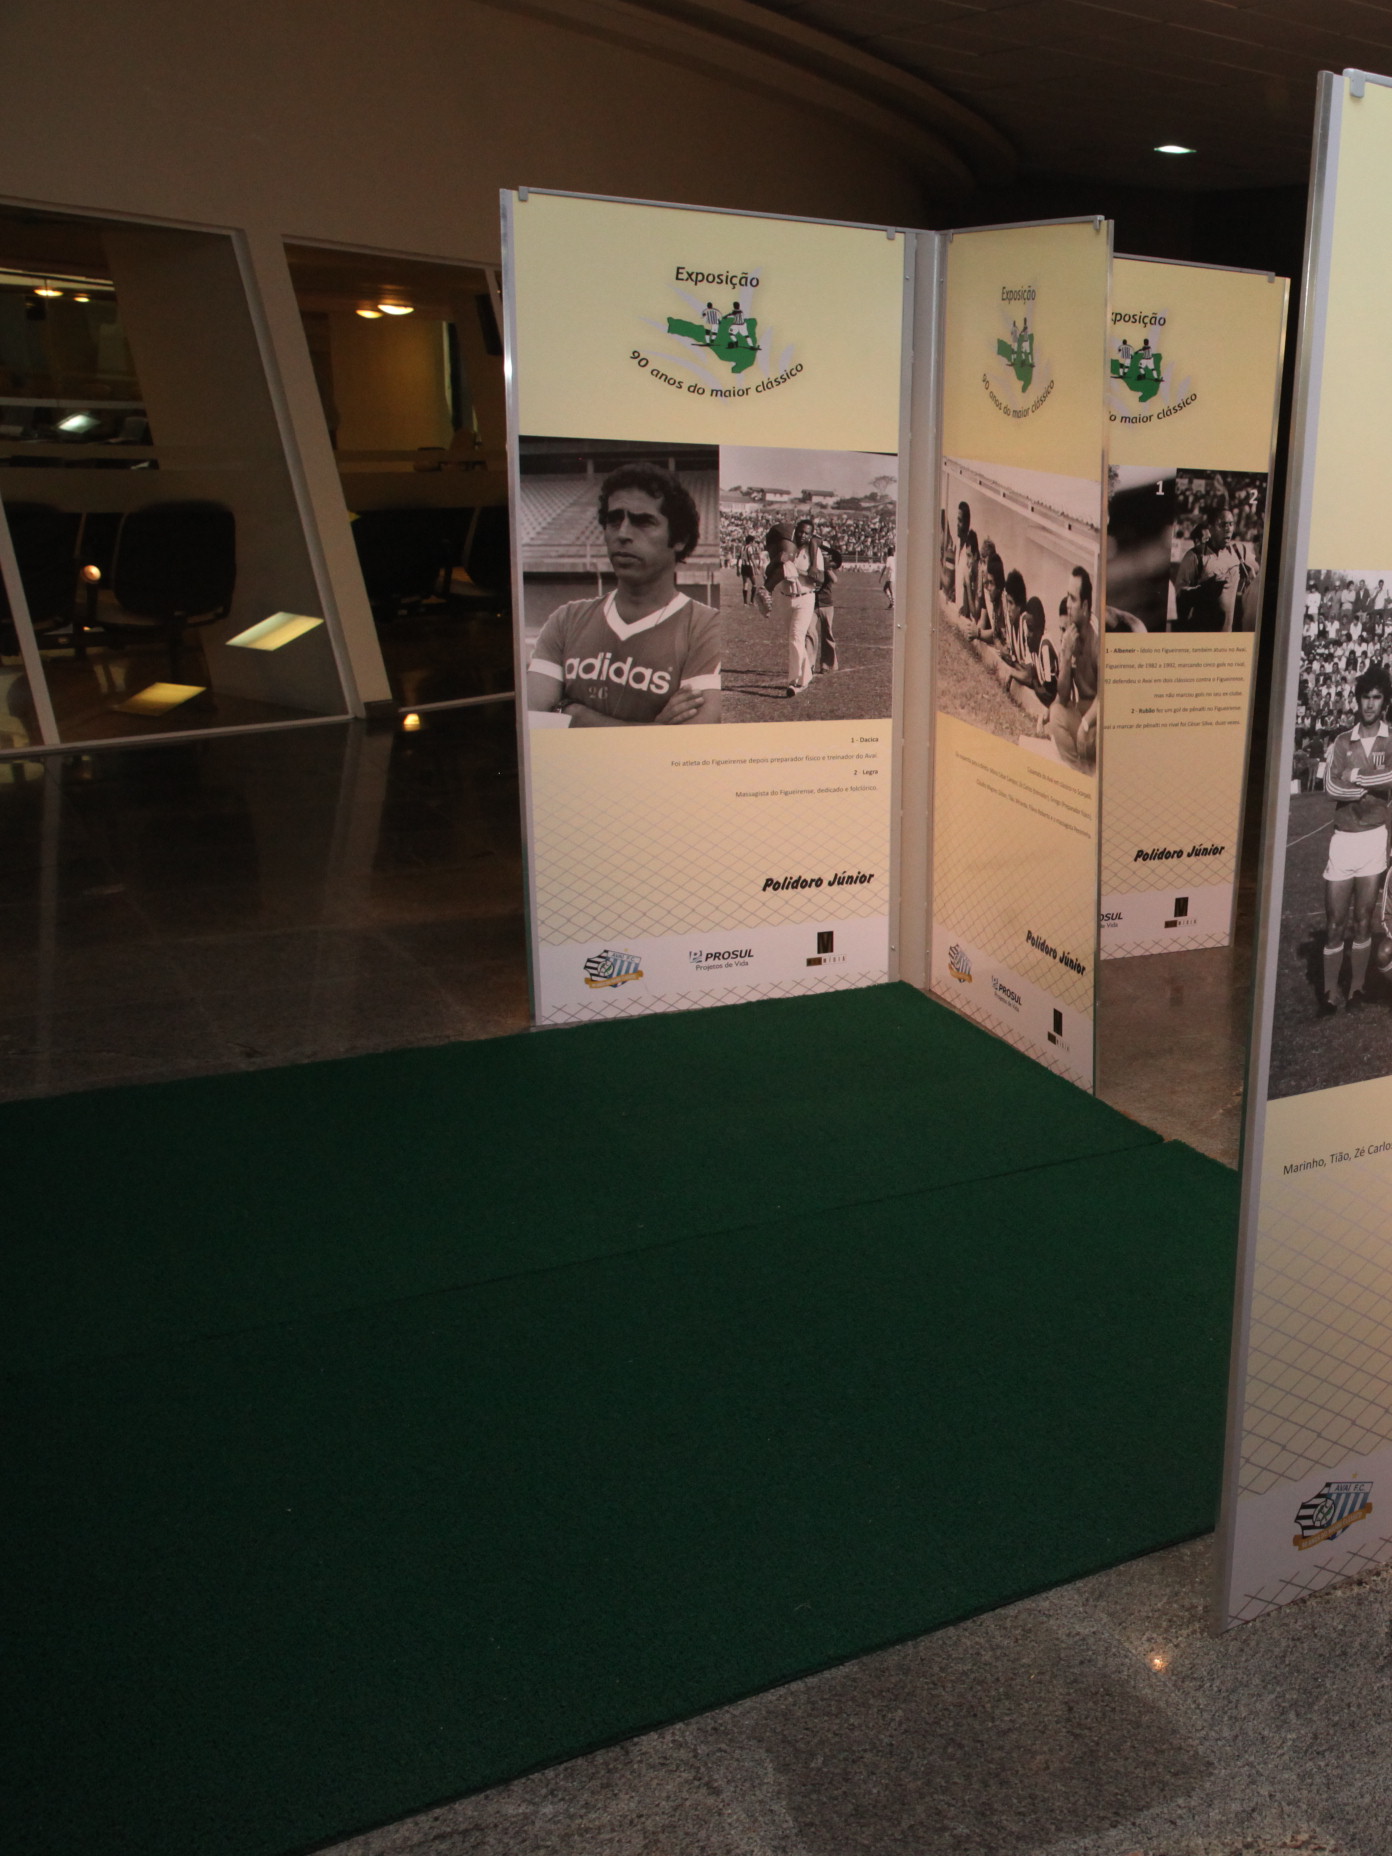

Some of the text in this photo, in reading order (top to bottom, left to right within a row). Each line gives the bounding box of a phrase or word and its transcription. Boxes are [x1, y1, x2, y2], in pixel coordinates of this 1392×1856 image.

[675, 266, 760, 290] Exposição
[1001, 285, 1036, 304] Exposição
[1111, 311, 1166, 328] posição
[629, 350, 804, 398] 90 anos do maior clássico
[1012, 403, 1029, 419] maior
[1031, 379, 1055, 414] clássico
[1120, 392, 1197, 424] maior clássico
[1155, 480, 1165, 495] 1
[1249, 489, 1258, 504] 2
[565, 652, 671, 695] adidas
[1134, 843, 1225, 862] Polidoro Júnior
[762, 871, 874, 892] Polidoro Júnior
[705, 949, 754, 962] PROSUL
[1026, 930, 1086, 976] Polidoro Júnior
[695, 963, 723, 971] Projetos
[998, 983, 1022, 1006] PROSUL
[1283, 1157, 1327, 1175] Marinho,
[1330, 1151, 1352, 1164] Tião,
[1353, 1145, 1366, 1158] Zé
